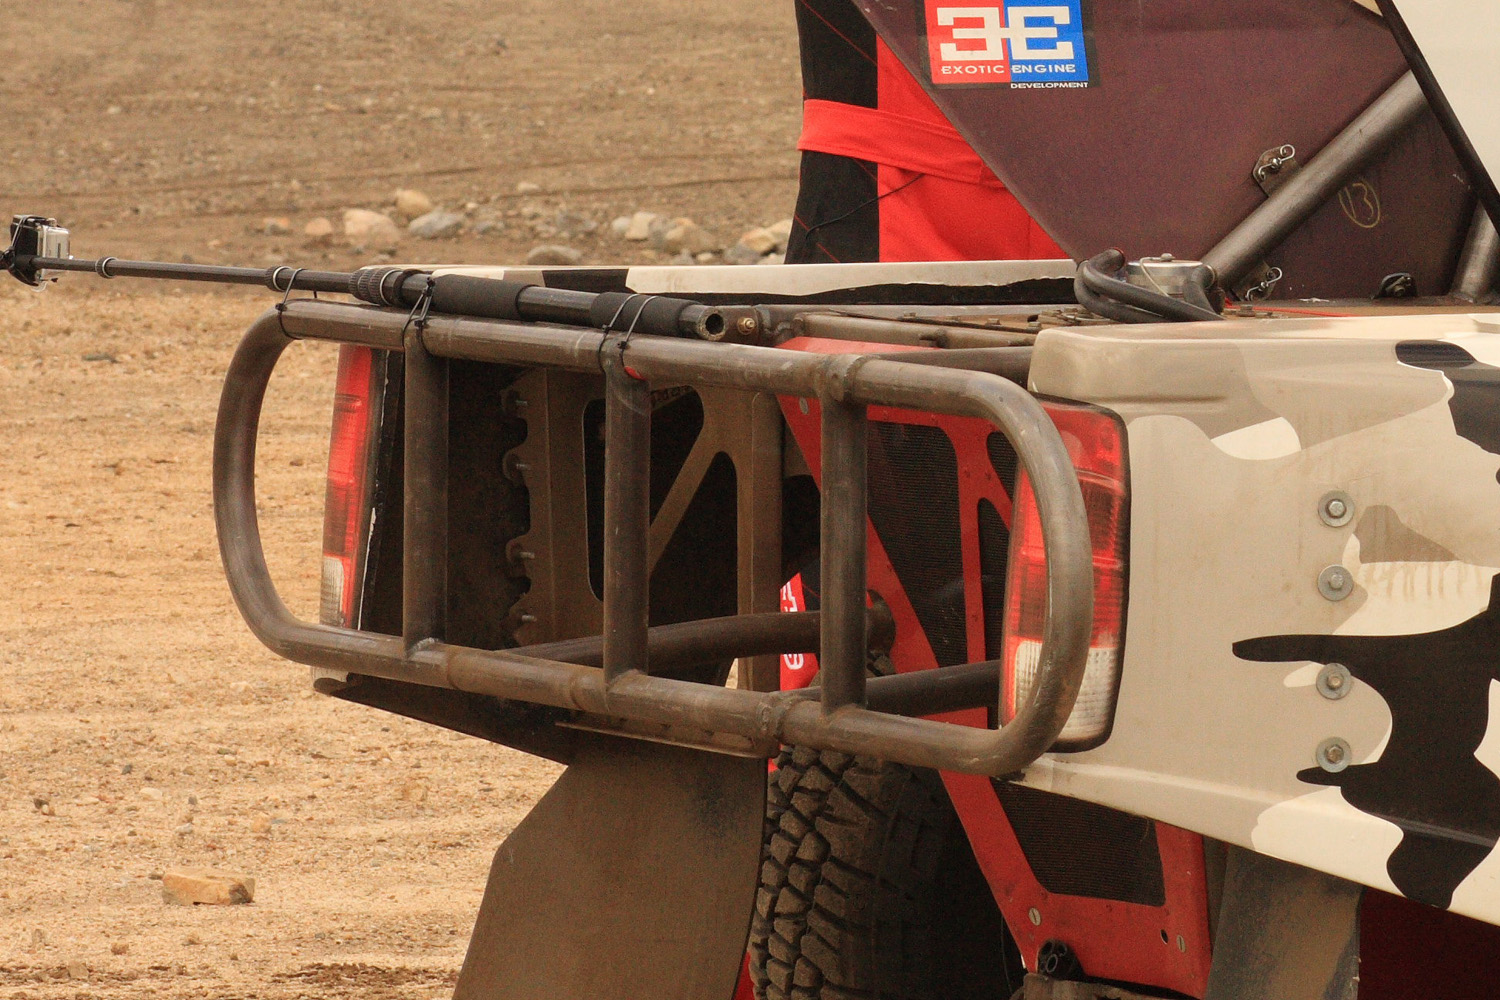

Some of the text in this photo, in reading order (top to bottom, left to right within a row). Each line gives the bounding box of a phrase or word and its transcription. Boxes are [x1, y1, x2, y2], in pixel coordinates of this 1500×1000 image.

[941, 64, 1076, 74] EXOTIC ENGINE
[1010, 81, 1089, 89] DEVELOPMENT
